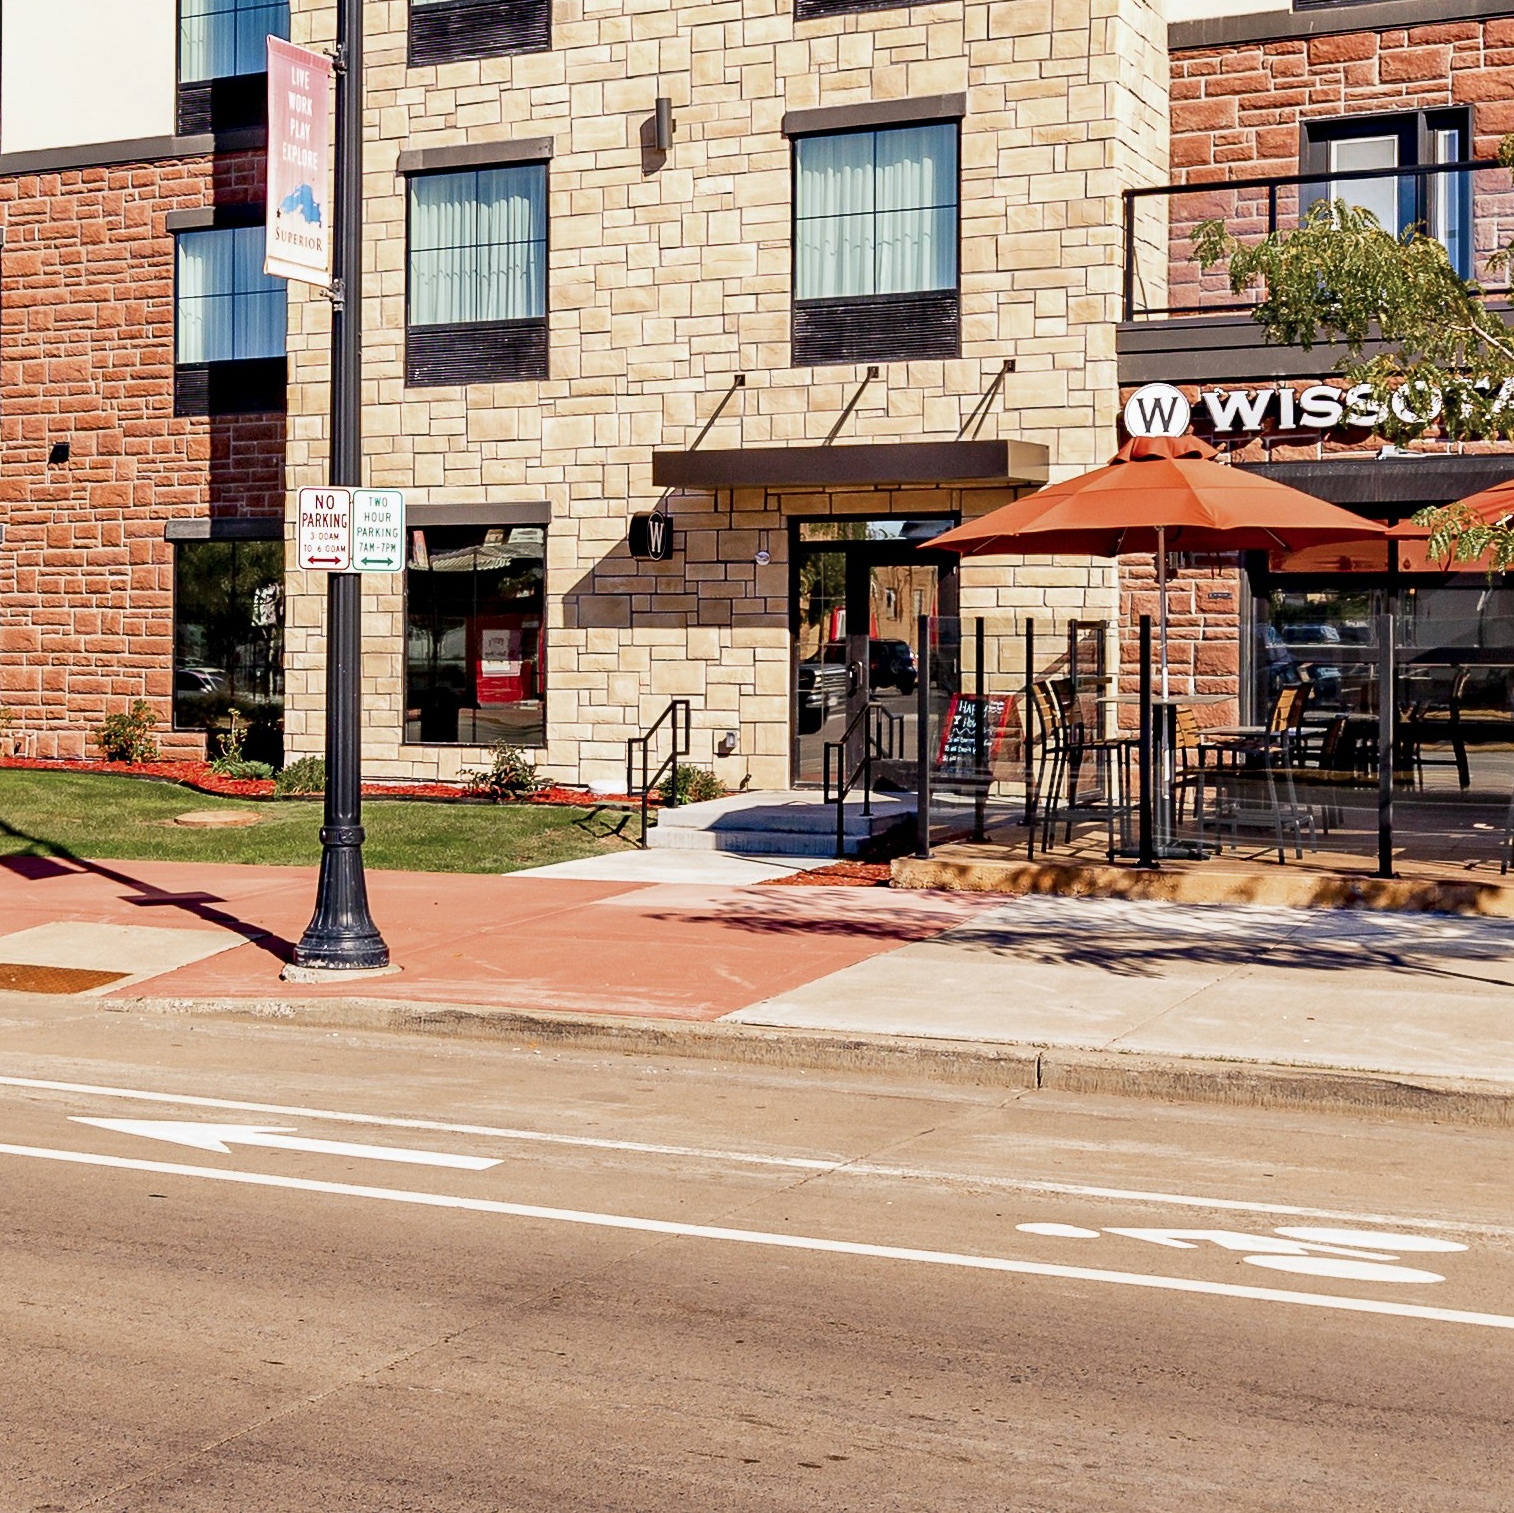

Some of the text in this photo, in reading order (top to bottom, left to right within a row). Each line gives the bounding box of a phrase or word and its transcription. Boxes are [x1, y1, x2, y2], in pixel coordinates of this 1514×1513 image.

[291, 66, 310, 91] LIVE
[287, 91, 313, 117] WORK
[290, 118, 311, 142] PLAY
[282, 142, 318, 171] EXPLORE
[275, 226, 323, 253] SUPERIOR
[1136, 396, 1180, 433] W
[315, 494, 335, 510] NO
[369, 496, 388, 508] TWO
[302, 513, 348, 529] PARKING
[364, 512, 392, 523] HOUR
[357, 527, 398, 539] PARKING
[649, 521, 664, 553] W
[359, 542, 397, 554] 7AM-7PM
